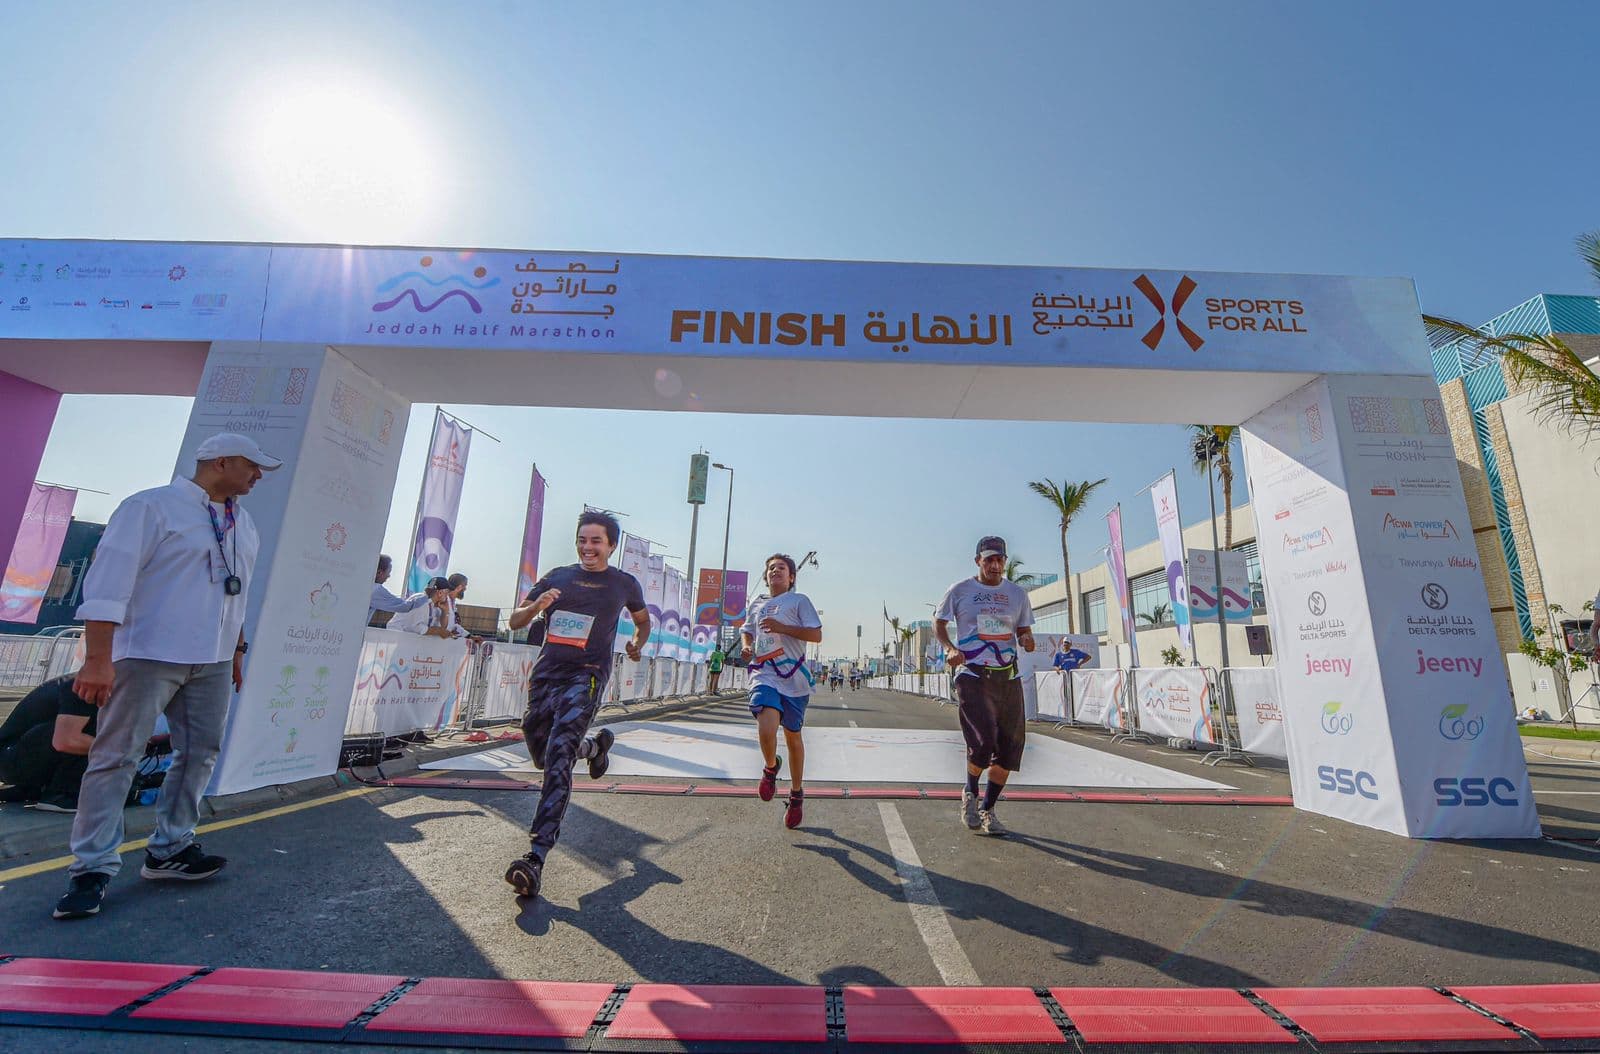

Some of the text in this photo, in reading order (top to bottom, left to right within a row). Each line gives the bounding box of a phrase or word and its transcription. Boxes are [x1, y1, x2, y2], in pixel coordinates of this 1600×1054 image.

[514, 257, 620, 274] نصف
[511, 275, 618, 298] ماراثون
[510, 298, 616, 320] جدة
[1031, 292, 1132, 313] الرياضة
[1204, 297, 1305, 316] SPORTS
[365, 322, 616, 339] Jeddah Half Marathon
[670, 309, 846, 347] FINISH
[863, 310, 1013, 353] النهاية
[1032, 310, 1134, 336] للجميع
[1207, 315, 1308, 333] FOR ALL
[224, 420, 267, 433] ROSHN
[1385, 451, 1427, 462] ROSHN
[1413, 520, 1443, 530] POWER
[554, 617, 585, 630] 5506
[1407, 615, 1474, 627] دلتا الرياضة
[1300, 629, 1347, 641] DELTA SPORTS
[1408, 627, 1476, 636] DELTA SPORTS
[1305, 652, 1353, 678] jeeny
[1416, 648, 1483, 678] jeeny
[1317, 765, 1379, 801] SSC
[1433, 776, 1519, 807] SSC
